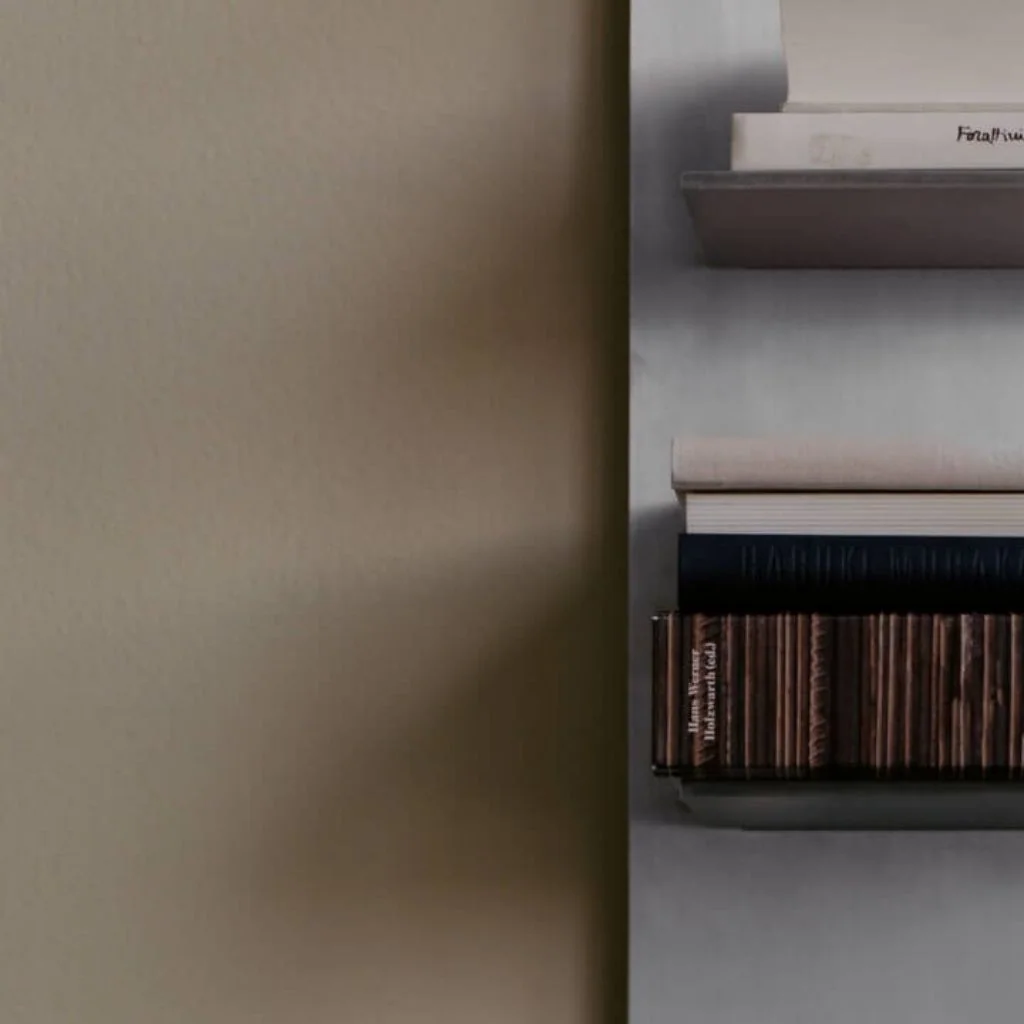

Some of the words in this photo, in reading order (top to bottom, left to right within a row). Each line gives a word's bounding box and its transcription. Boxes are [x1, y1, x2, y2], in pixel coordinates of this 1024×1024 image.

[687, 648, 700, 696] Werner
[687, 699, 699, 733] Hans
[703, 671, 716, 740] Holzwarth
